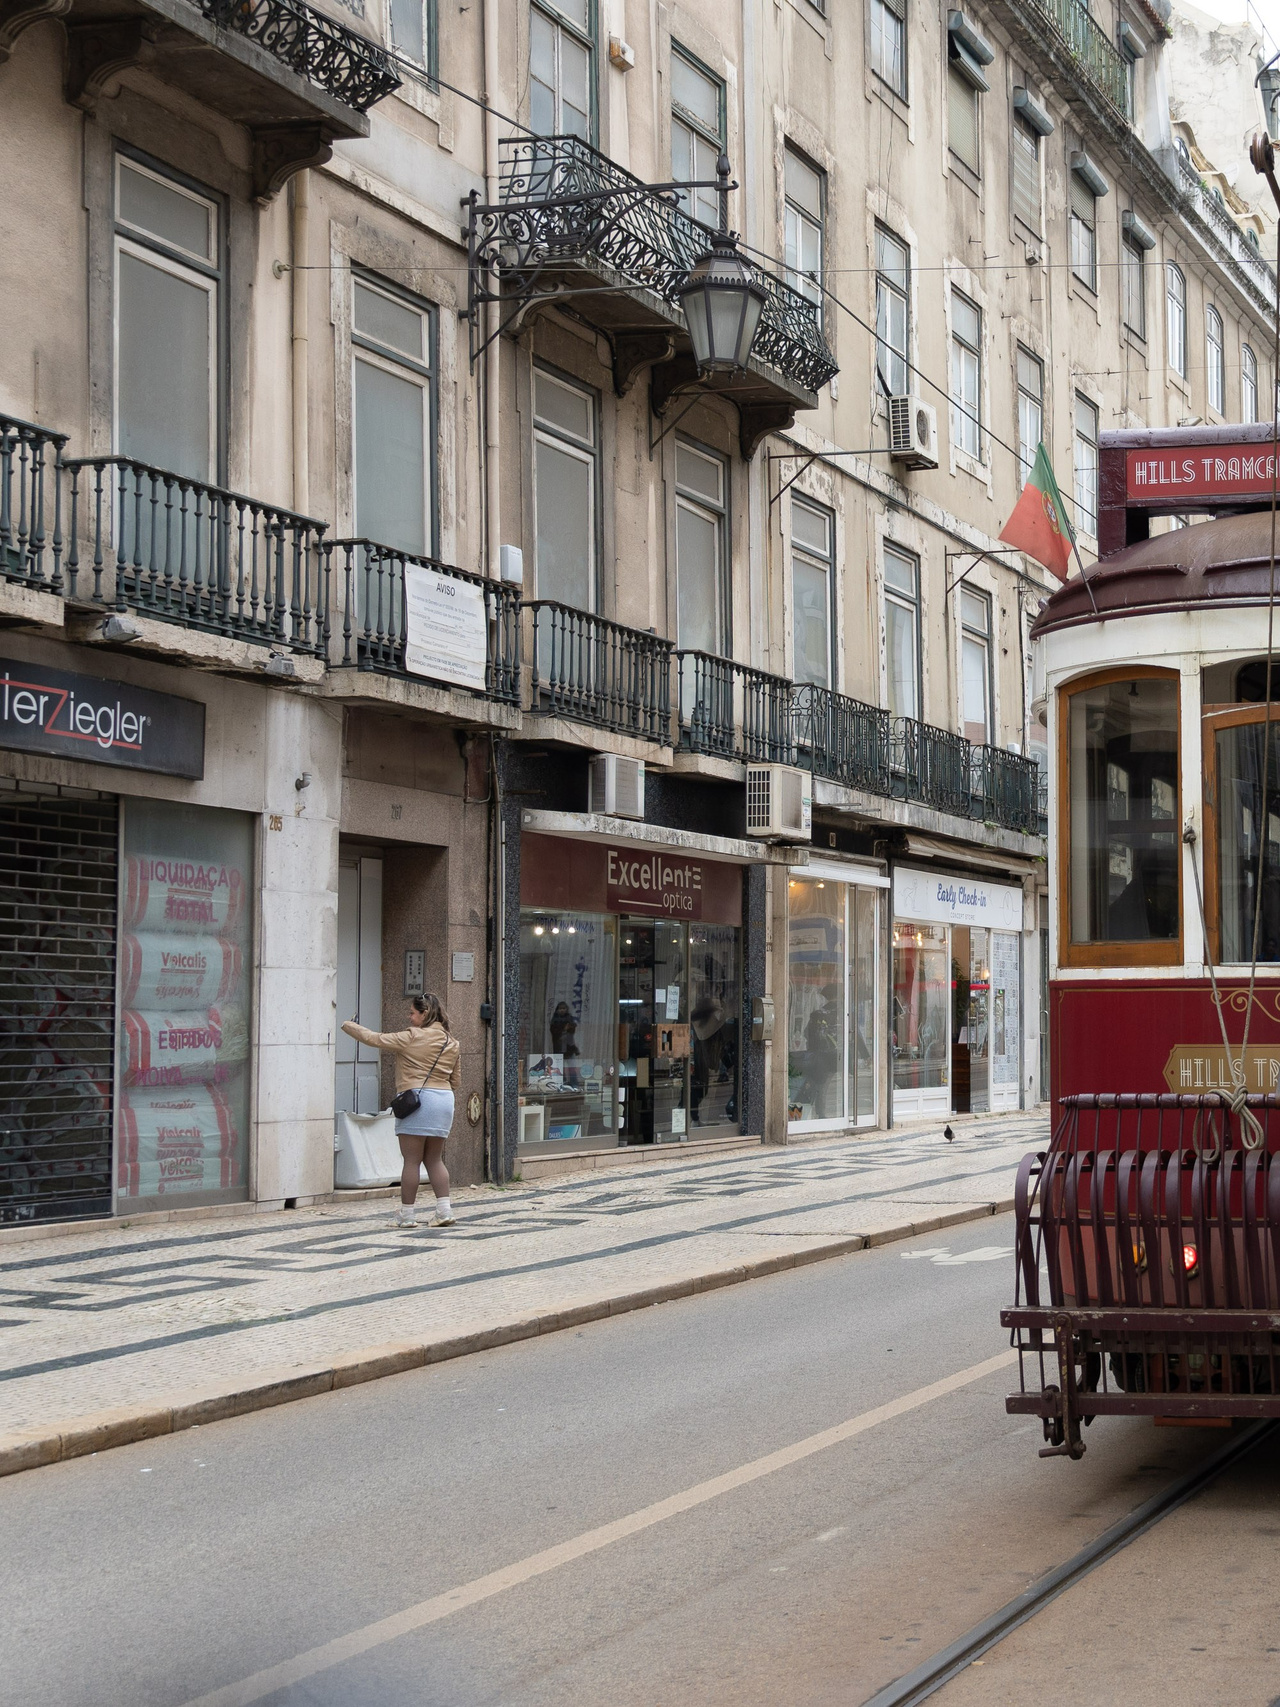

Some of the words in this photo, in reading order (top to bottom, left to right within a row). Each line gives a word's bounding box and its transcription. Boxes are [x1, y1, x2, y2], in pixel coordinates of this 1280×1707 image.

[1135, 459, 1195, 485] HILLS
[436, 582, 456, 597] AVISO
[269, 814, 283, 832] 265
[663, 890, 693, 914] optica
[936, 883, 957, 910] Early
[958, 886, 987, 908] Check-in
[1180, 1058, 1247, 1088] HILLS
